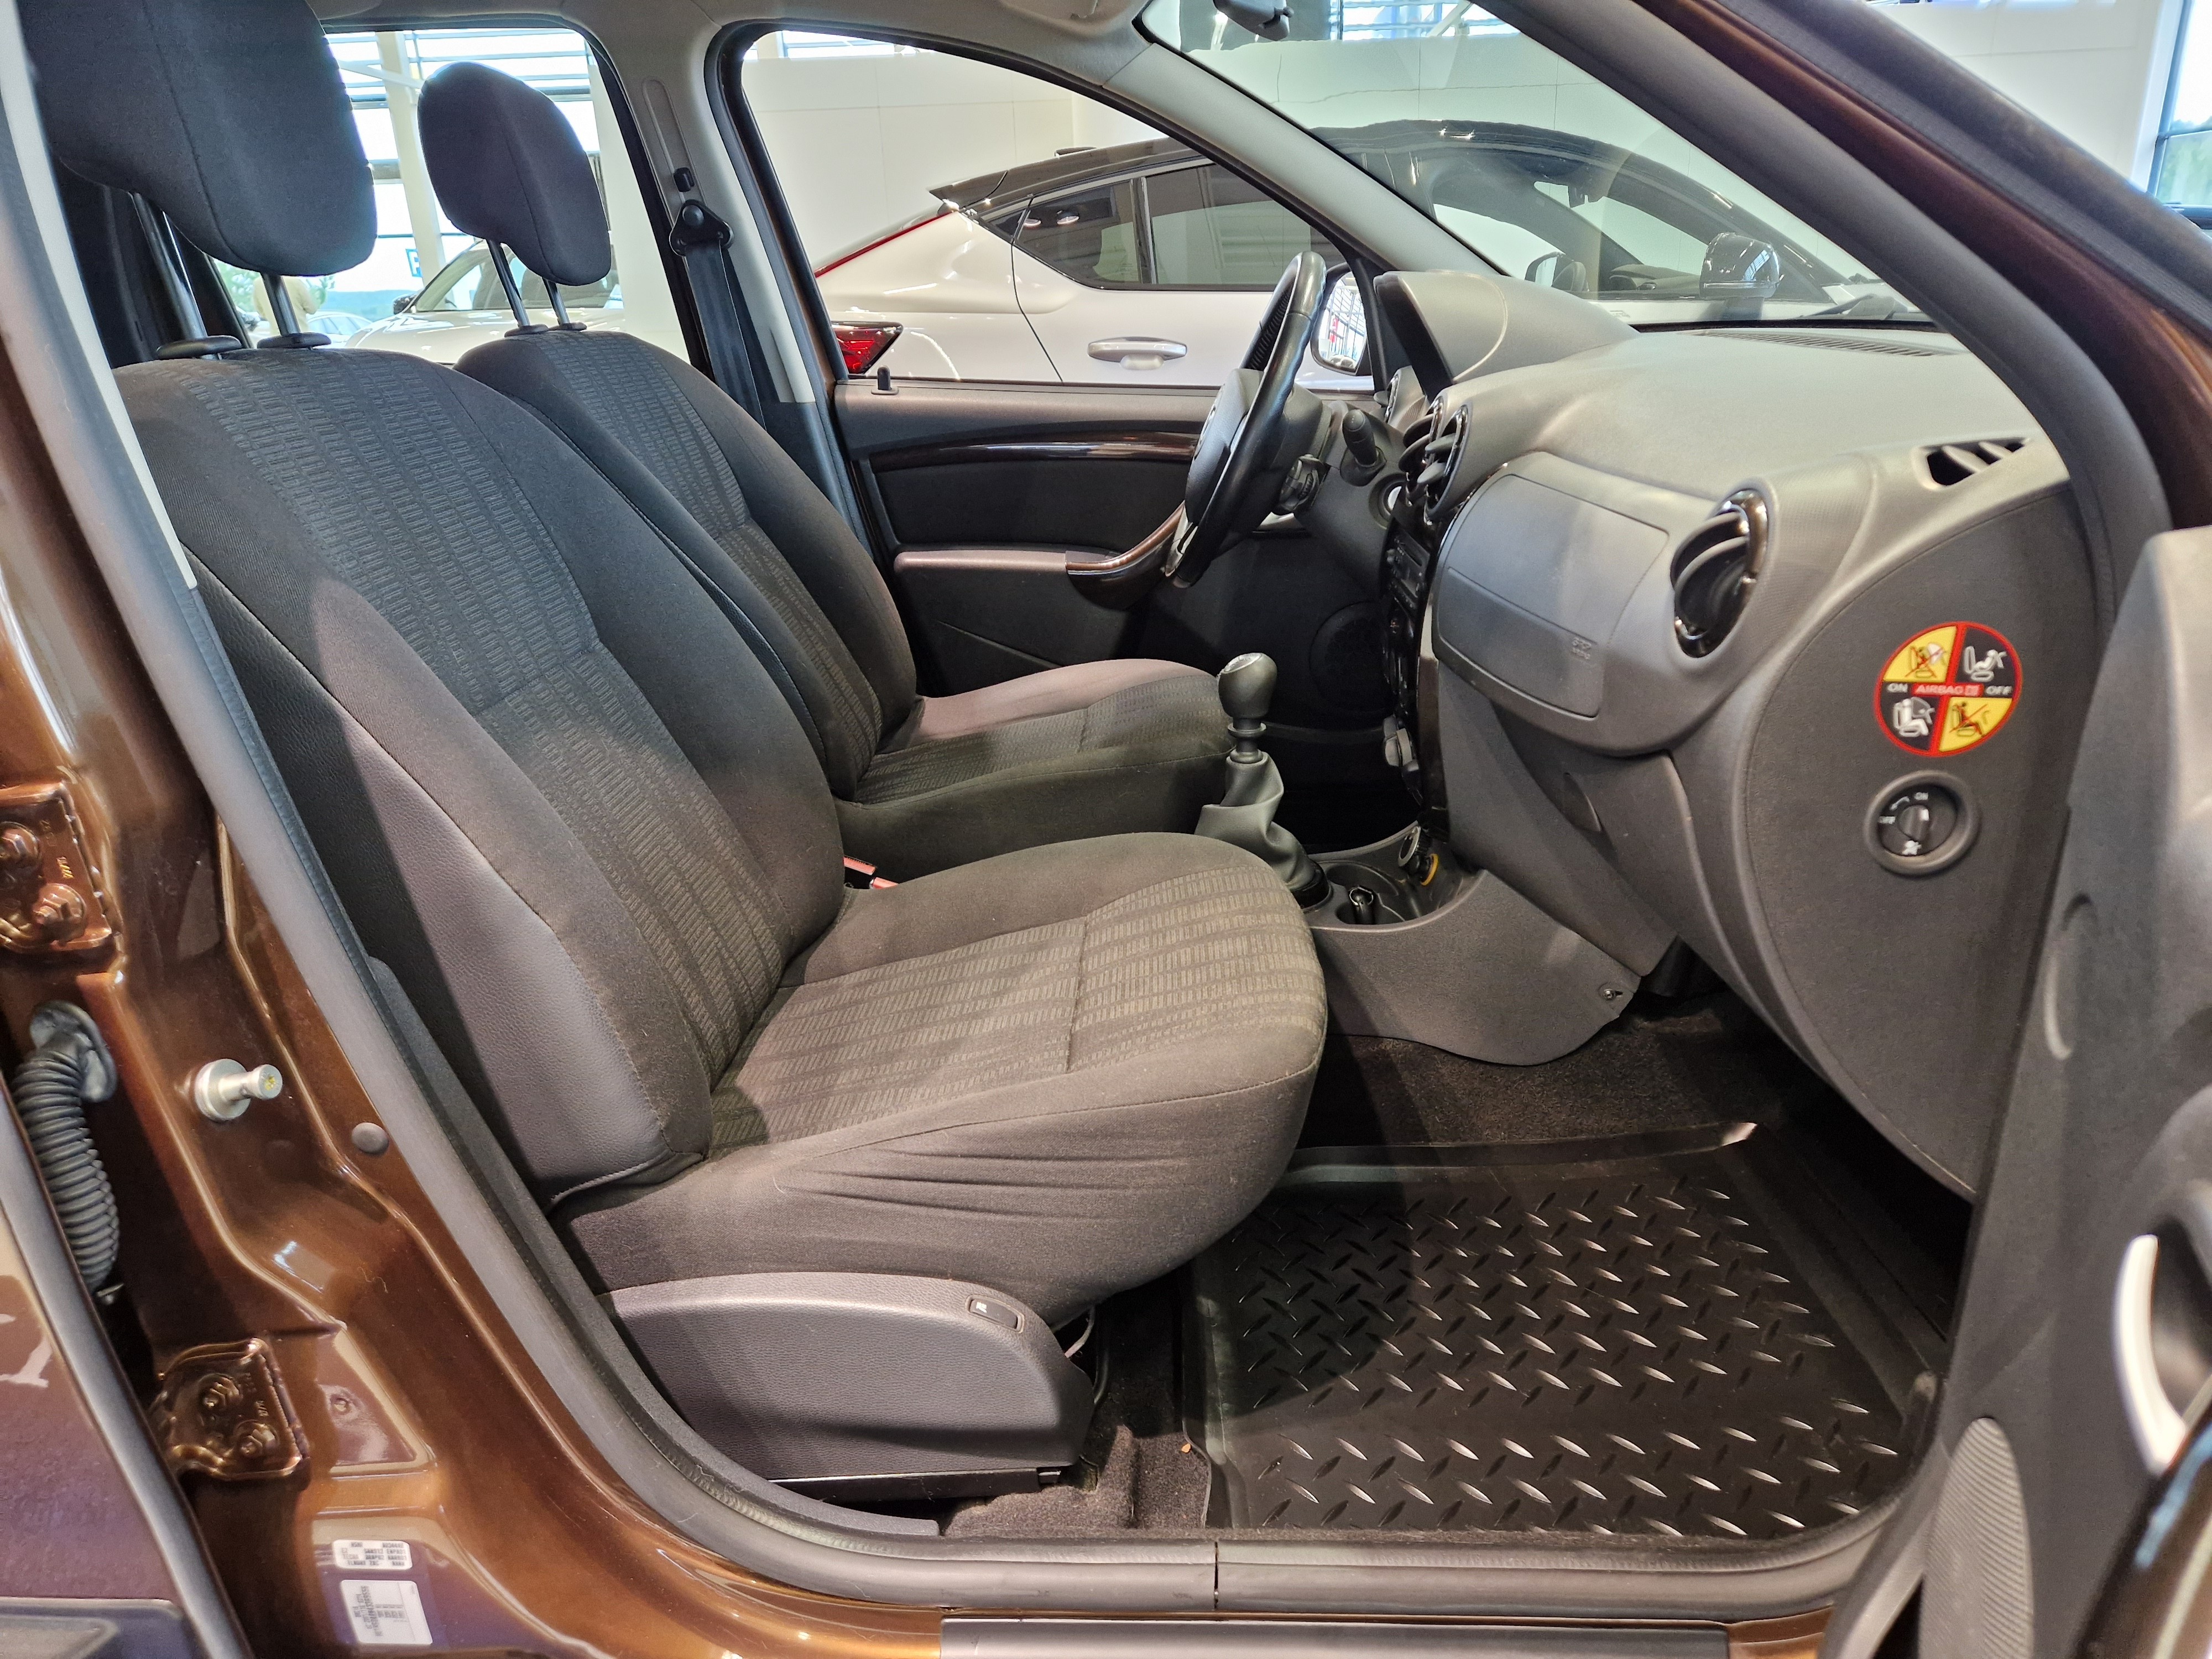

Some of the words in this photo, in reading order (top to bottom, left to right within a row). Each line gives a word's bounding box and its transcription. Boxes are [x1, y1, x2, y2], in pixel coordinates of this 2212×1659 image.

[1886, 682, 1908, 693] ON
[1915, 684, 1964, 696] AIRBAG
[1985, 685, 2013, 696] OFF
[1914, 791, 1929, 801] ON
